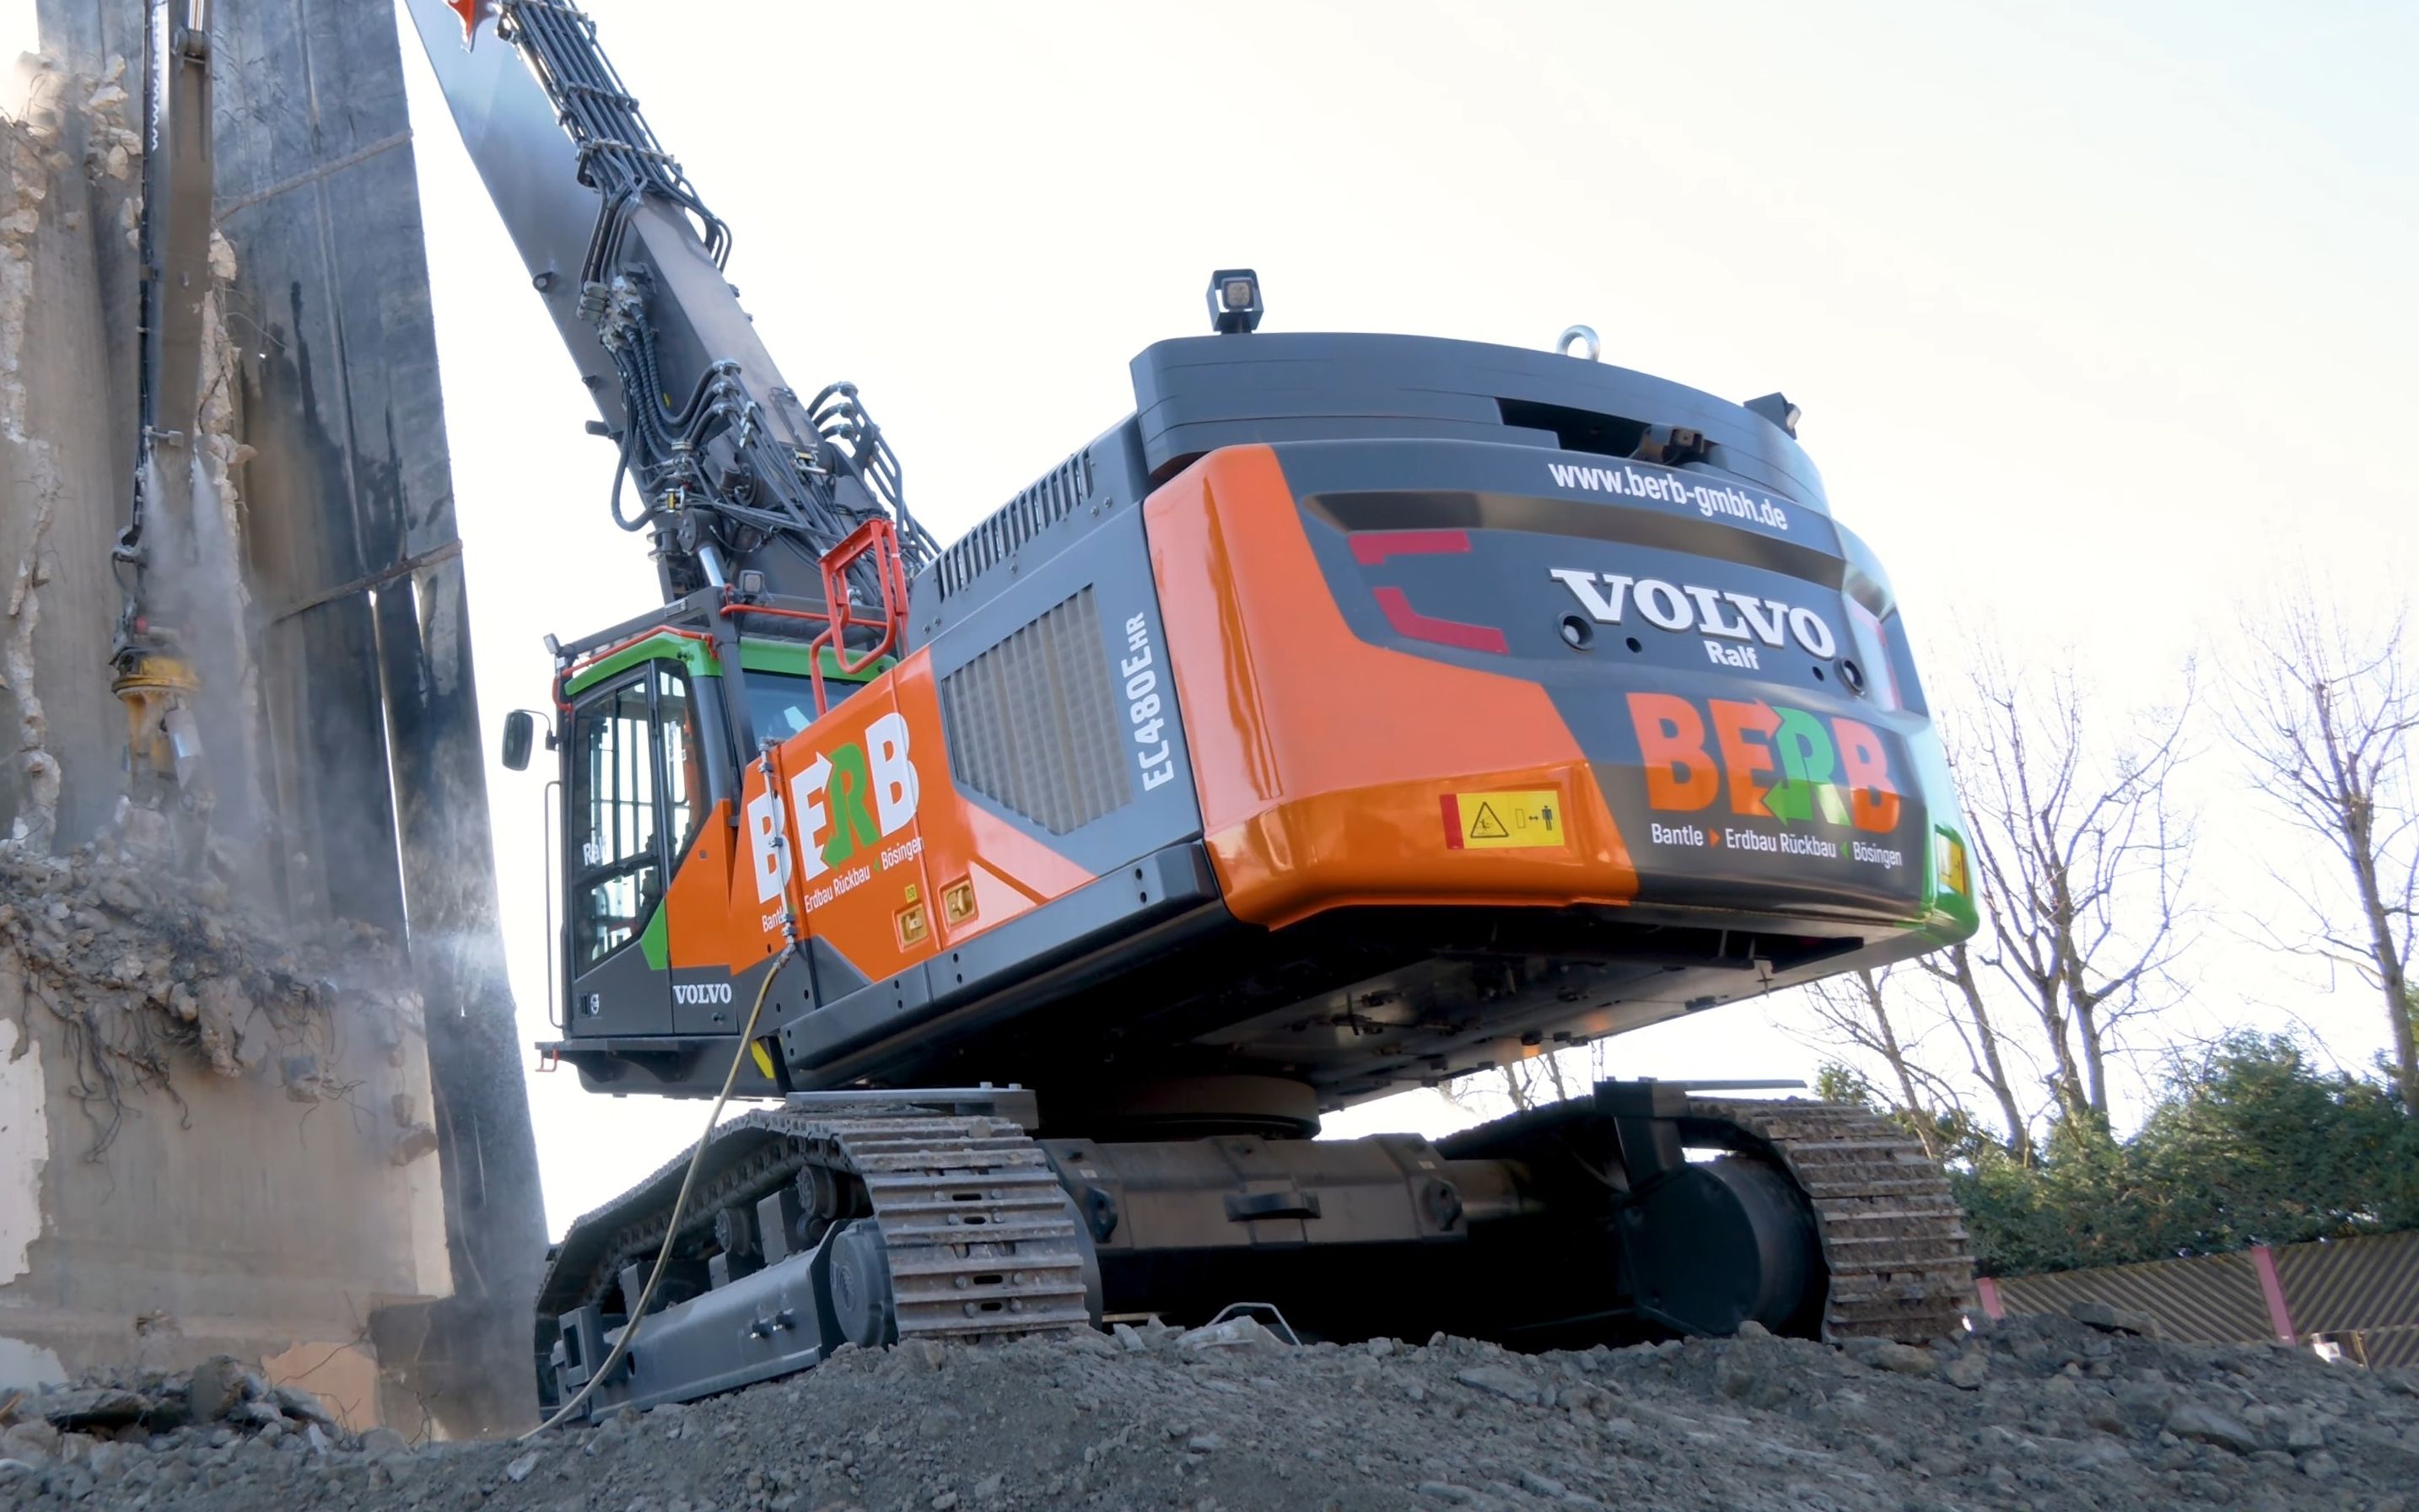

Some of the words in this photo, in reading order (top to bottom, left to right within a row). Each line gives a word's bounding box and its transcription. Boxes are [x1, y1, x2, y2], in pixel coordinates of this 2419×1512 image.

[1549, 463, 1788, 530] www.berb-gmbh.de
[1549, 568, 1836, 660] VOLVO
[1703, 640, 1760, 670] Ralf
[1627, 692, 1900, 833] BERB
[747, 713, 919, 904] BERB
[805, 885, 834, 913] Erdbau
[833, 864, 870, 897] Rückbau
[881, 837, 924, 871] Bösingen
[1651, 824, 1704, 847] Bantle
[1726, 829, 1777, 853] Erdbau
[1781, 833, 1836, 858] Rückbau
[1853, 842, 1903, 869] Bösingen
[673, 982, 732, 1004] VOLVO
